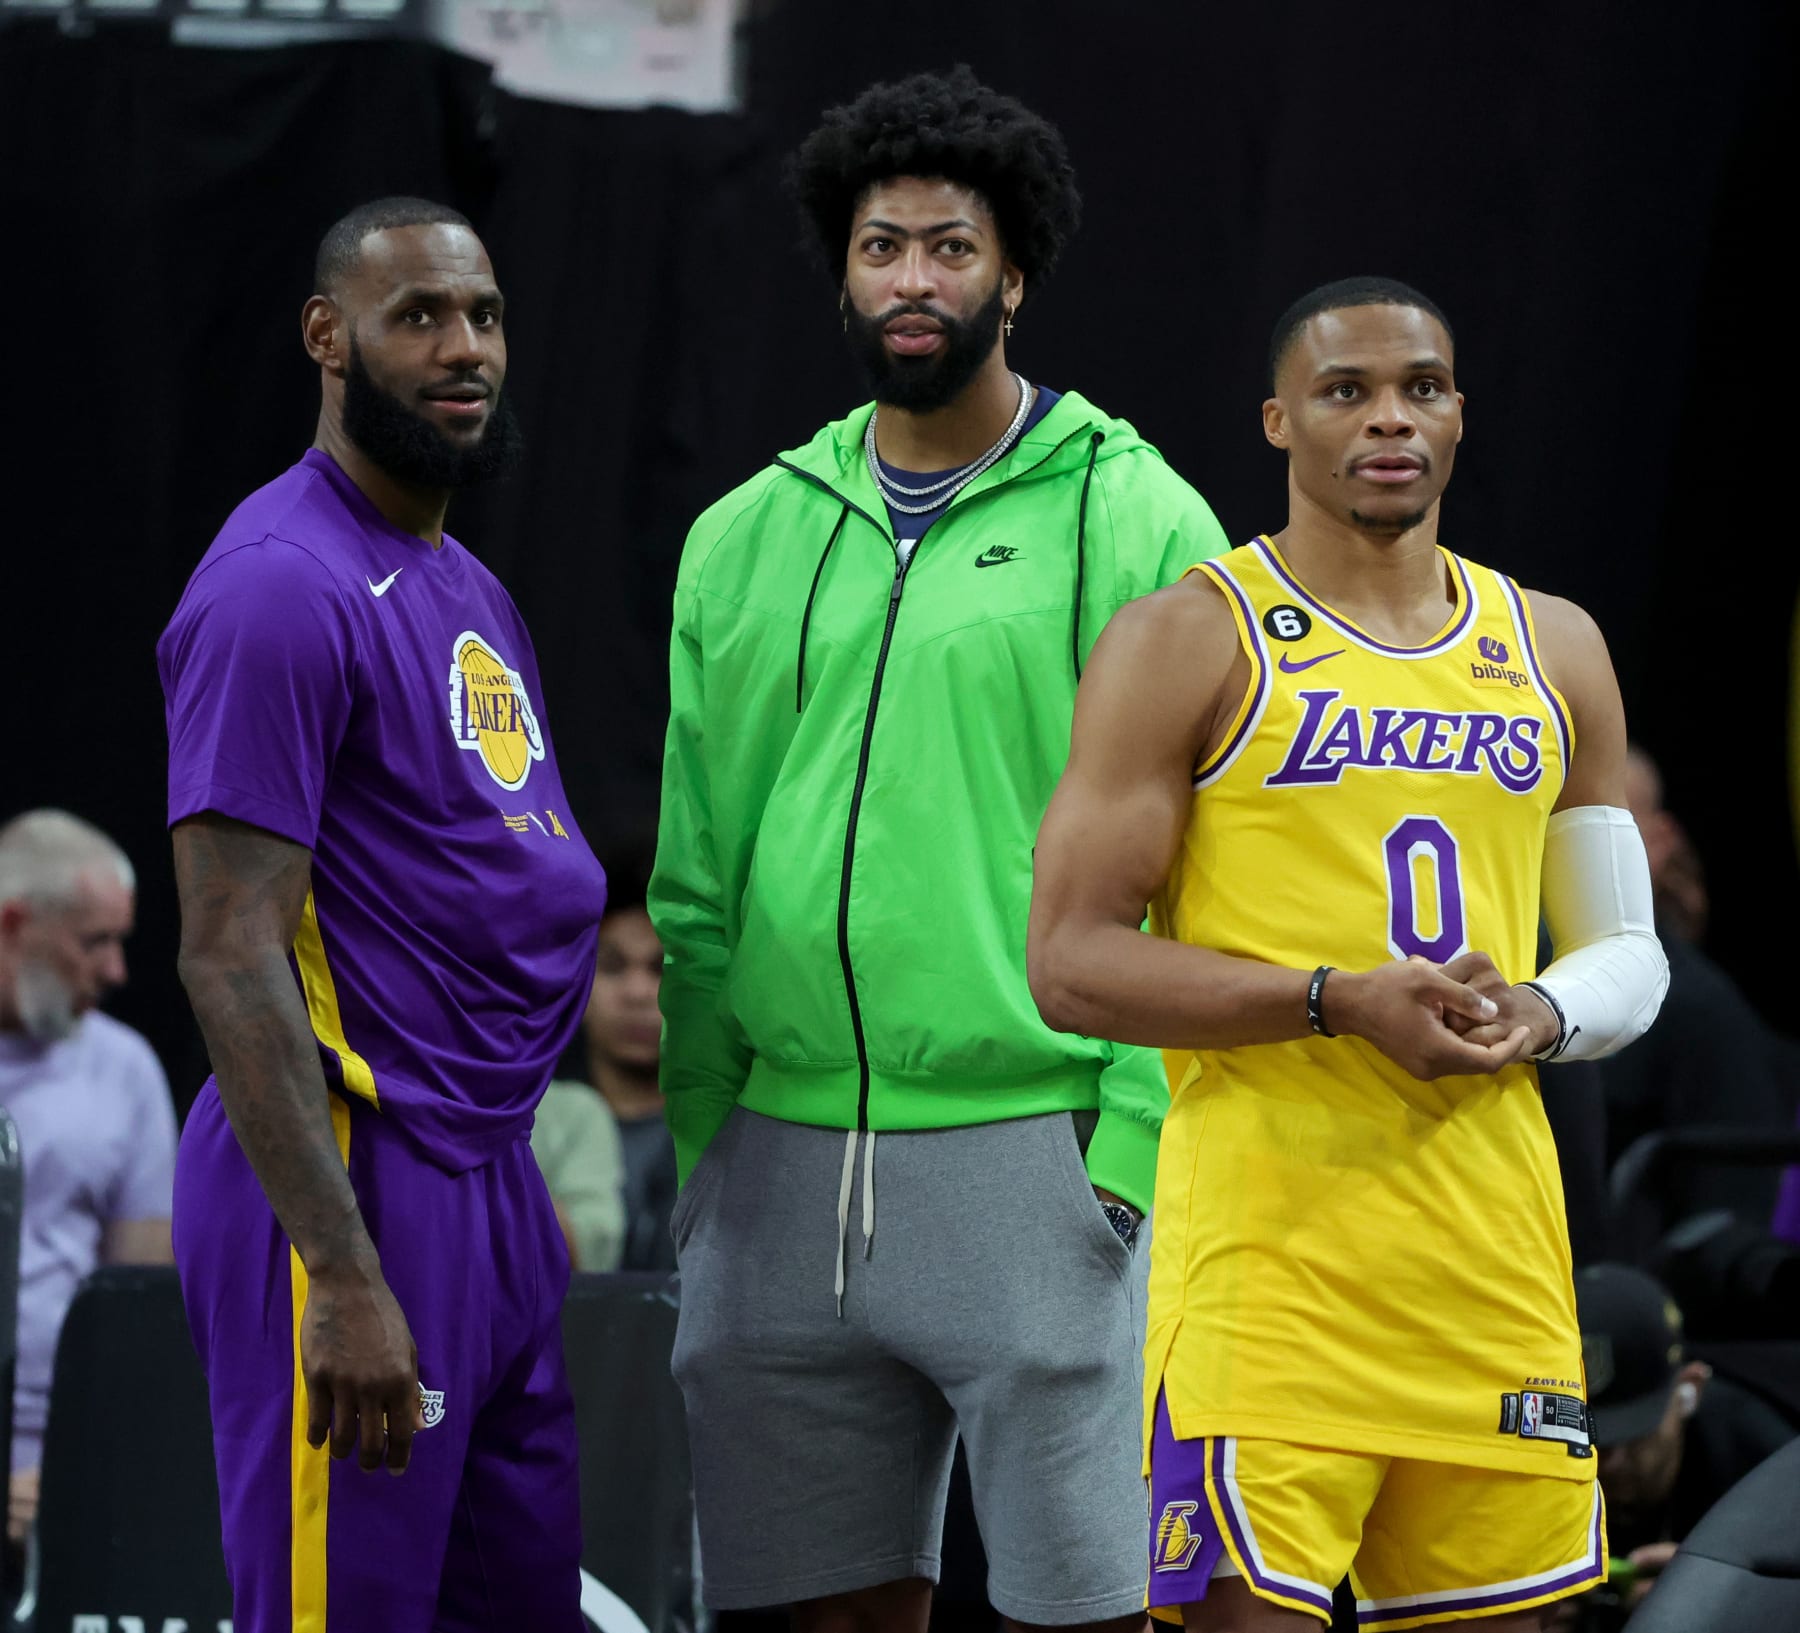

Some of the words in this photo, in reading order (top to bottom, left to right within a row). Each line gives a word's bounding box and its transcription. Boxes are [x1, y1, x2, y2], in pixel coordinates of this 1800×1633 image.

[984, 545, 1018, 561] NIKE
[1272, 609, 1303, 637] 6
[471, 672, 485, 686] LOS
[1471, 663, 1529, 688] bibigo
[455, 670, 541, 751] LAKERS
[1262, 689, 1544, 796] LAKERS
[1381, 814, 1471, 965] 0
[1525, 1377, 1557, 1387] LEAVE
[1559, 1379, 1565, 1387] A
[1545, 1405, 1555, 1415] 50
